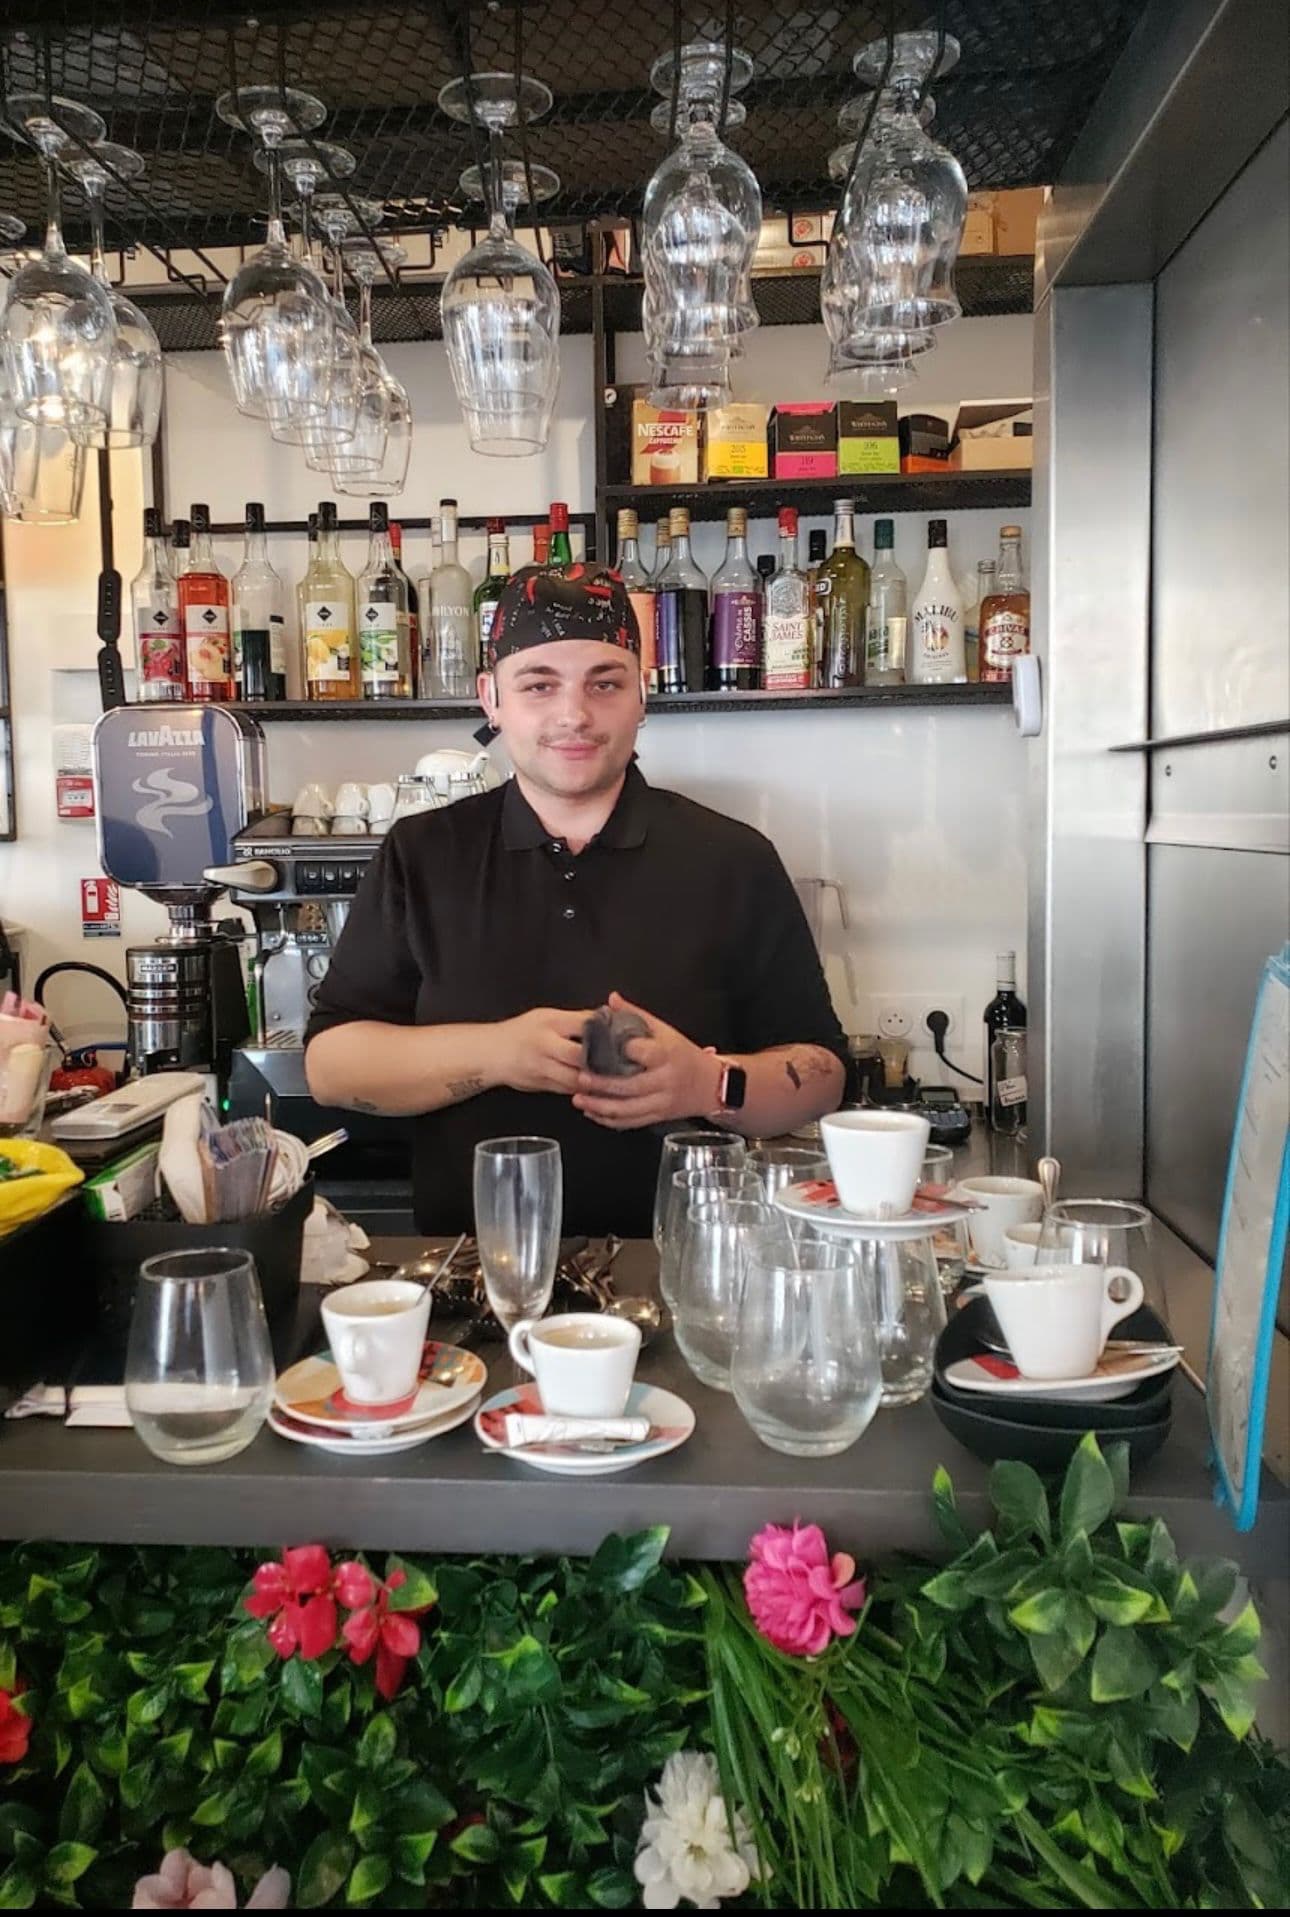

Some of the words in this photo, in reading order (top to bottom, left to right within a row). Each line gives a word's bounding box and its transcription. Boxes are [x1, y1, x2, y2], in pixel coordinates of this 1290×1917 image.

[914, 604, 960, 622] MALIBU
[743, 607, 752, 641] CASSIS
[772, 622, 801, 631] SAINT
[771, 631, 804, 641] JAMES
[128, 725, 206, 747] LAVAZZA
